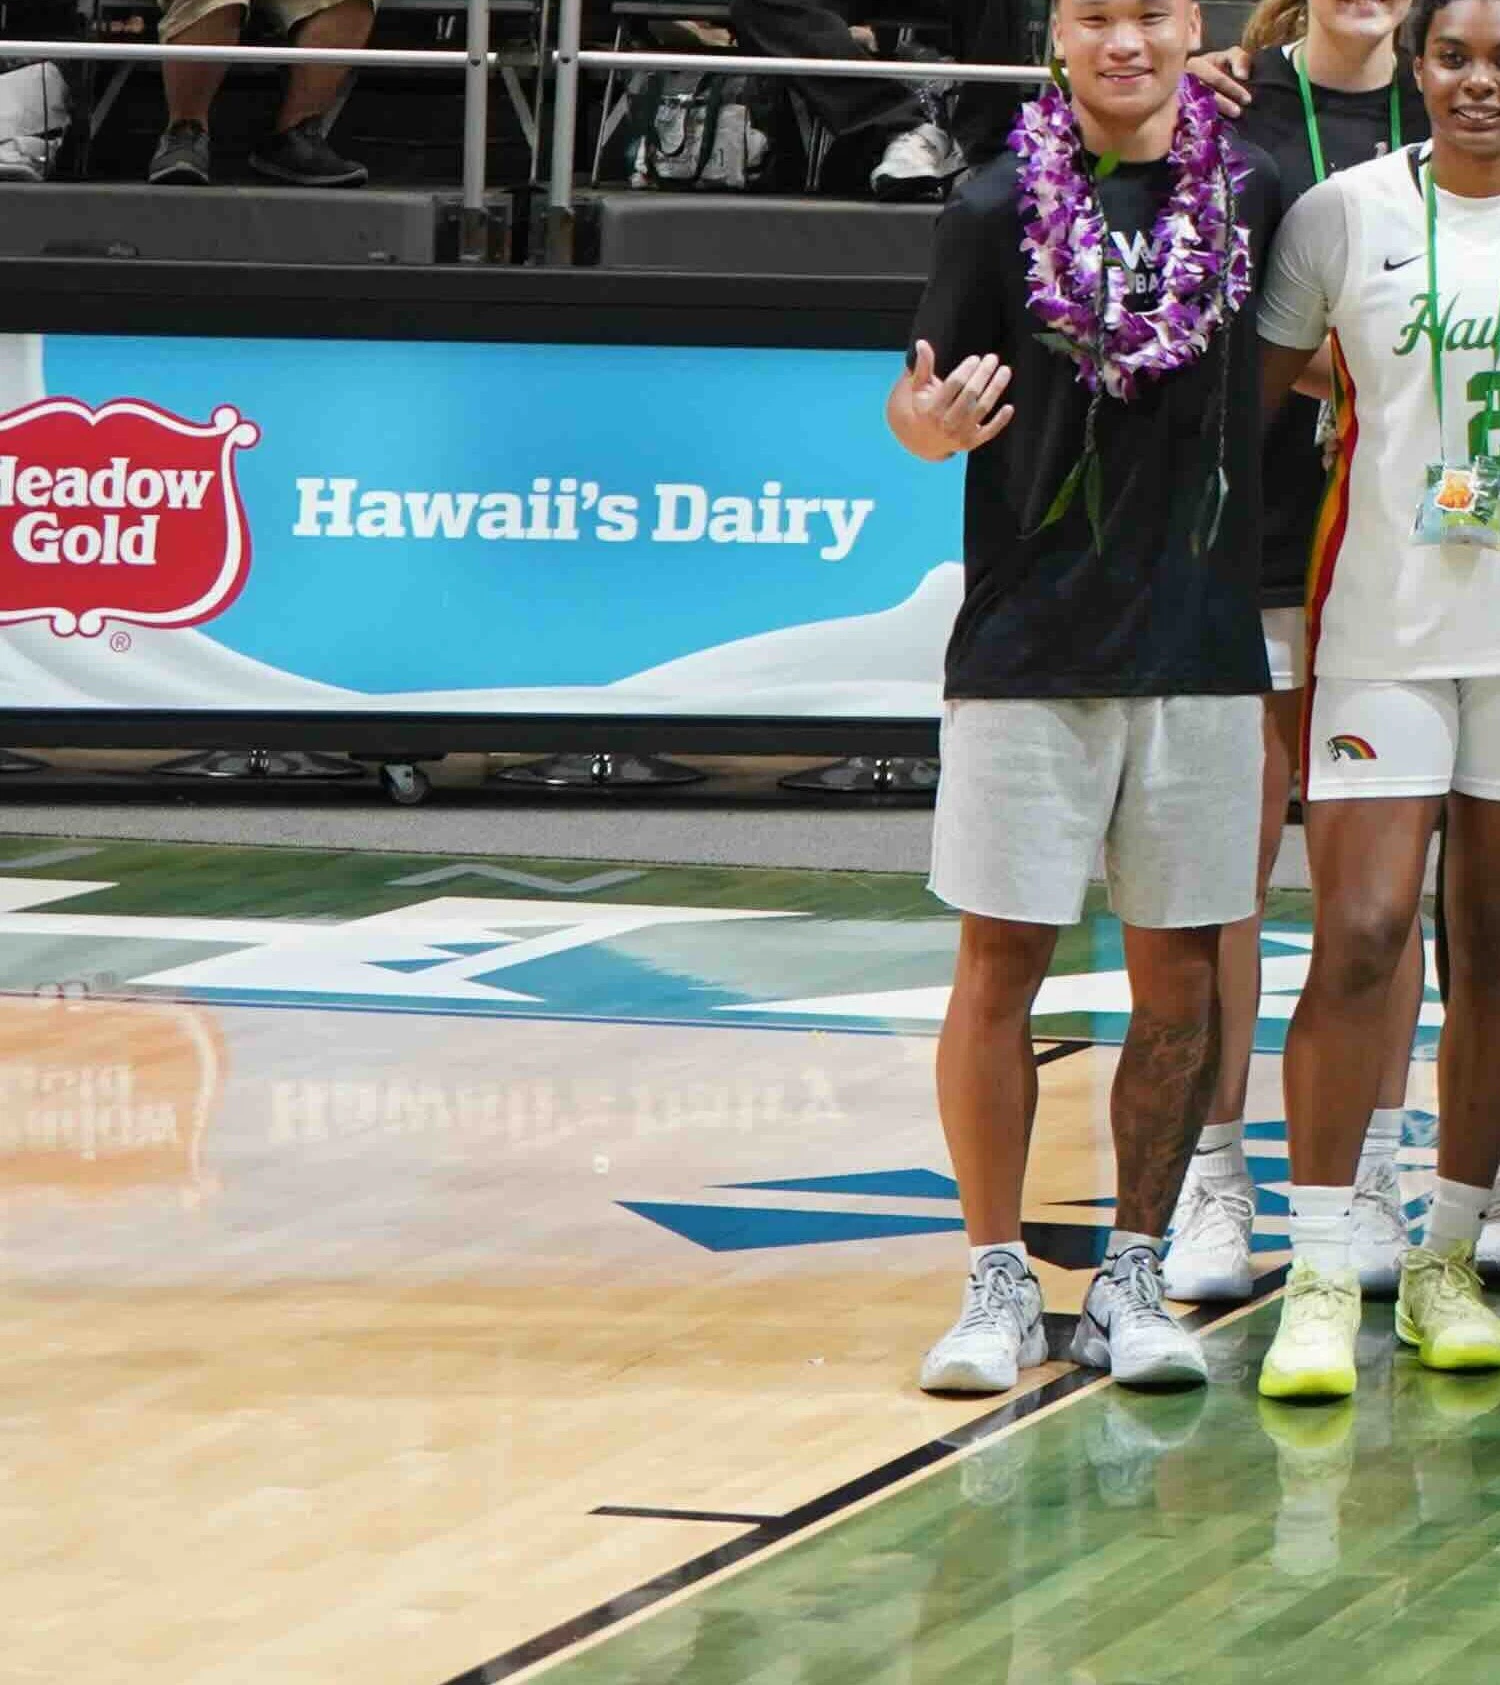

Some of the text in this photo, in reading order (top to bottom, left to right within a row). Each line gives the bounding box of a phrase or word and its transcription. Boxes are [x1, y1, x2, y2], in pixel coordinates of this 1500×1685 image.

[12, 511, 157, 567] Gold
[293, 476, 873, 562] Hawaii's Dairy
